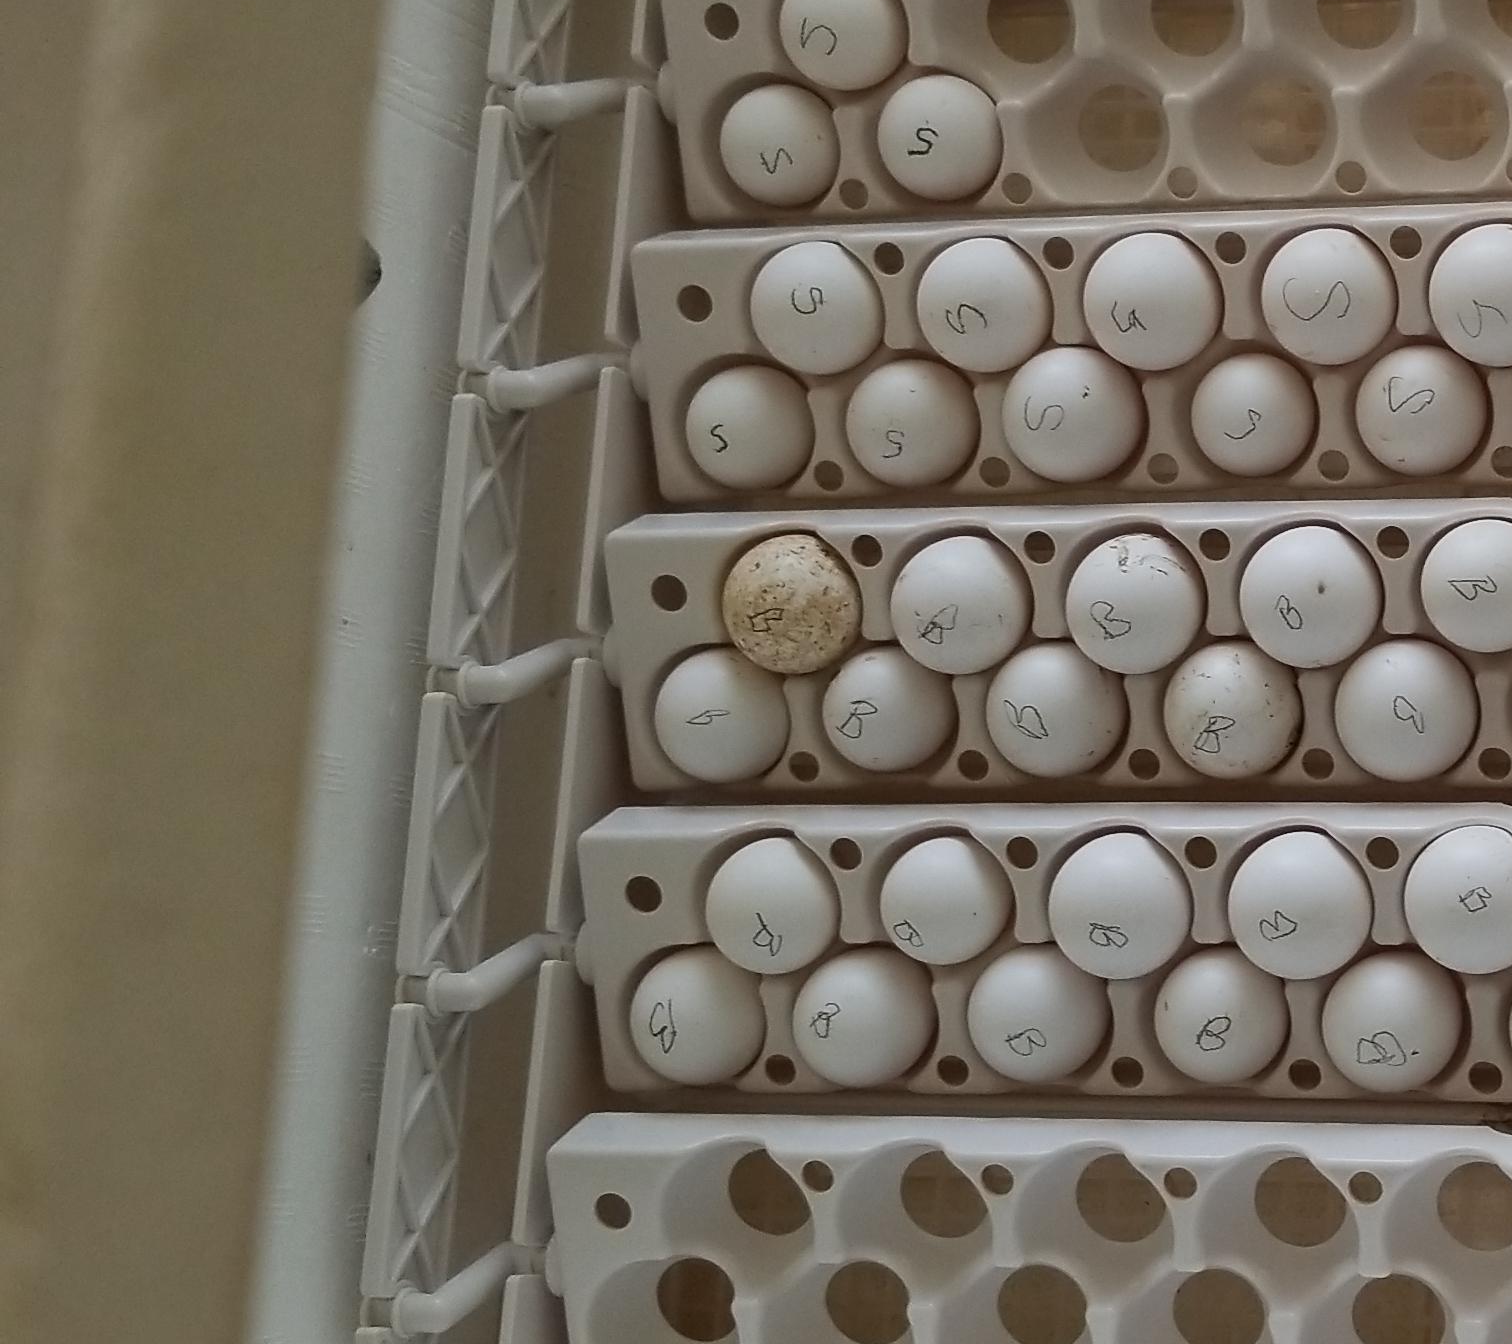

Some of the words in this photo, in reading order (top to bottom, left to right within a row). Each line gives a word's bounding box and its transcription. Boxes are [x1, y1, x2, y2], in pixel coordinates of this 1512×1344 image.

[800, 17, 837, 56] S
[907, 128, 938, 156] S
[760, 148, 793, 175] S
[791, 287, 823, 315] S
[1282, 278, 1351, 321] S
[945, 304, 987, 334] S
[1386, 375, 1436, 415] S
[1024, 396, 1064, 431] S
[710, 424, 728, 453] S
[882, 430, 904, 458] S
